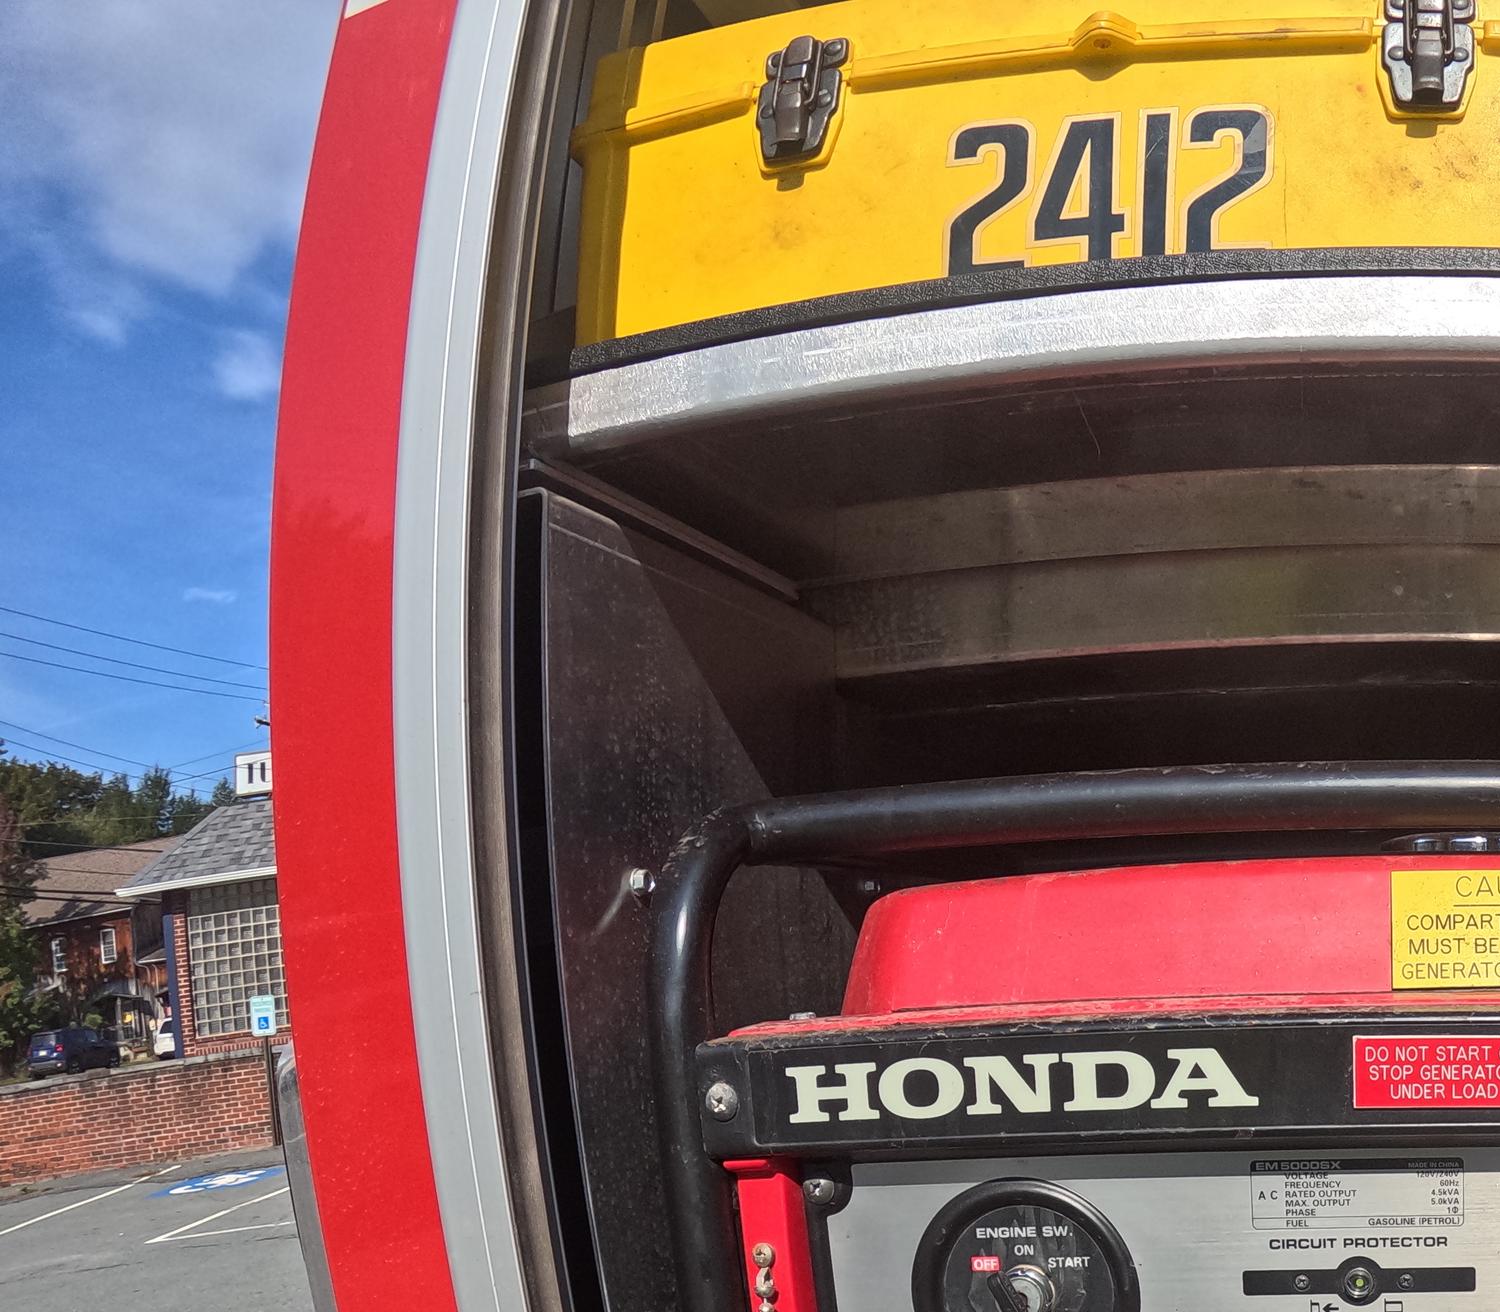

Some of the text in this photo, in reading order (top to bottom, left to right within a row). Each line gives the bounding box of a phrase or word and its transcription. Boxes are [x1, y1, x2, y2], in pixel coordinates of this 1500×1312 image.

[944, 103, 1272, 277] 2412
[1408, 938, 1466, 955] MUST
[1474, 937, 1499, 954] BE
[1365, 1046, 1389, 1062] DO
[1395, 1046, 1429, 1062] NOT
[1436, 1046, 1492, 1062] START
[1369, 1065, 1413, 1080] STOP
[785, 1047, 1259, 1123] HONDA
[1390, 1083, 1498, 1099] UNDER LOAD
[1284, 1171, 1328, 1180] VOLTAGE
[1416, 1170, 1459, 1178] 120V/240V
[1284, 1181, 1341, 1189] FREQUENCY
[1439, 1179, 1459, 1187] 60Hz
[1285, 1189, 1357, 1198] RATED OUTPUT
[1431, 1188, 1459, 1196] 4.5kVA
[1285, 1199, 1351, 1207] MAX. OUTPUT
[1431, 1197, 1459, 1205] 5.0kVA
[1286, 1208, 1316, 1216] PHASE
[1286, 1219, 1309, 1227] FUEL
[1368, 1217, 1460, 1226] GASOLINE (PETROL)
[975, 1225, 1073, 1239] ENGINE SW.
[1269, 1236, 1448, 1250] CIRCUIT PROTECTOR
[1014, 1245, 1034, 1256] ON
[973, 1259, 999, 1270] OFF
[1048, 1256, 1091, 1268] START
